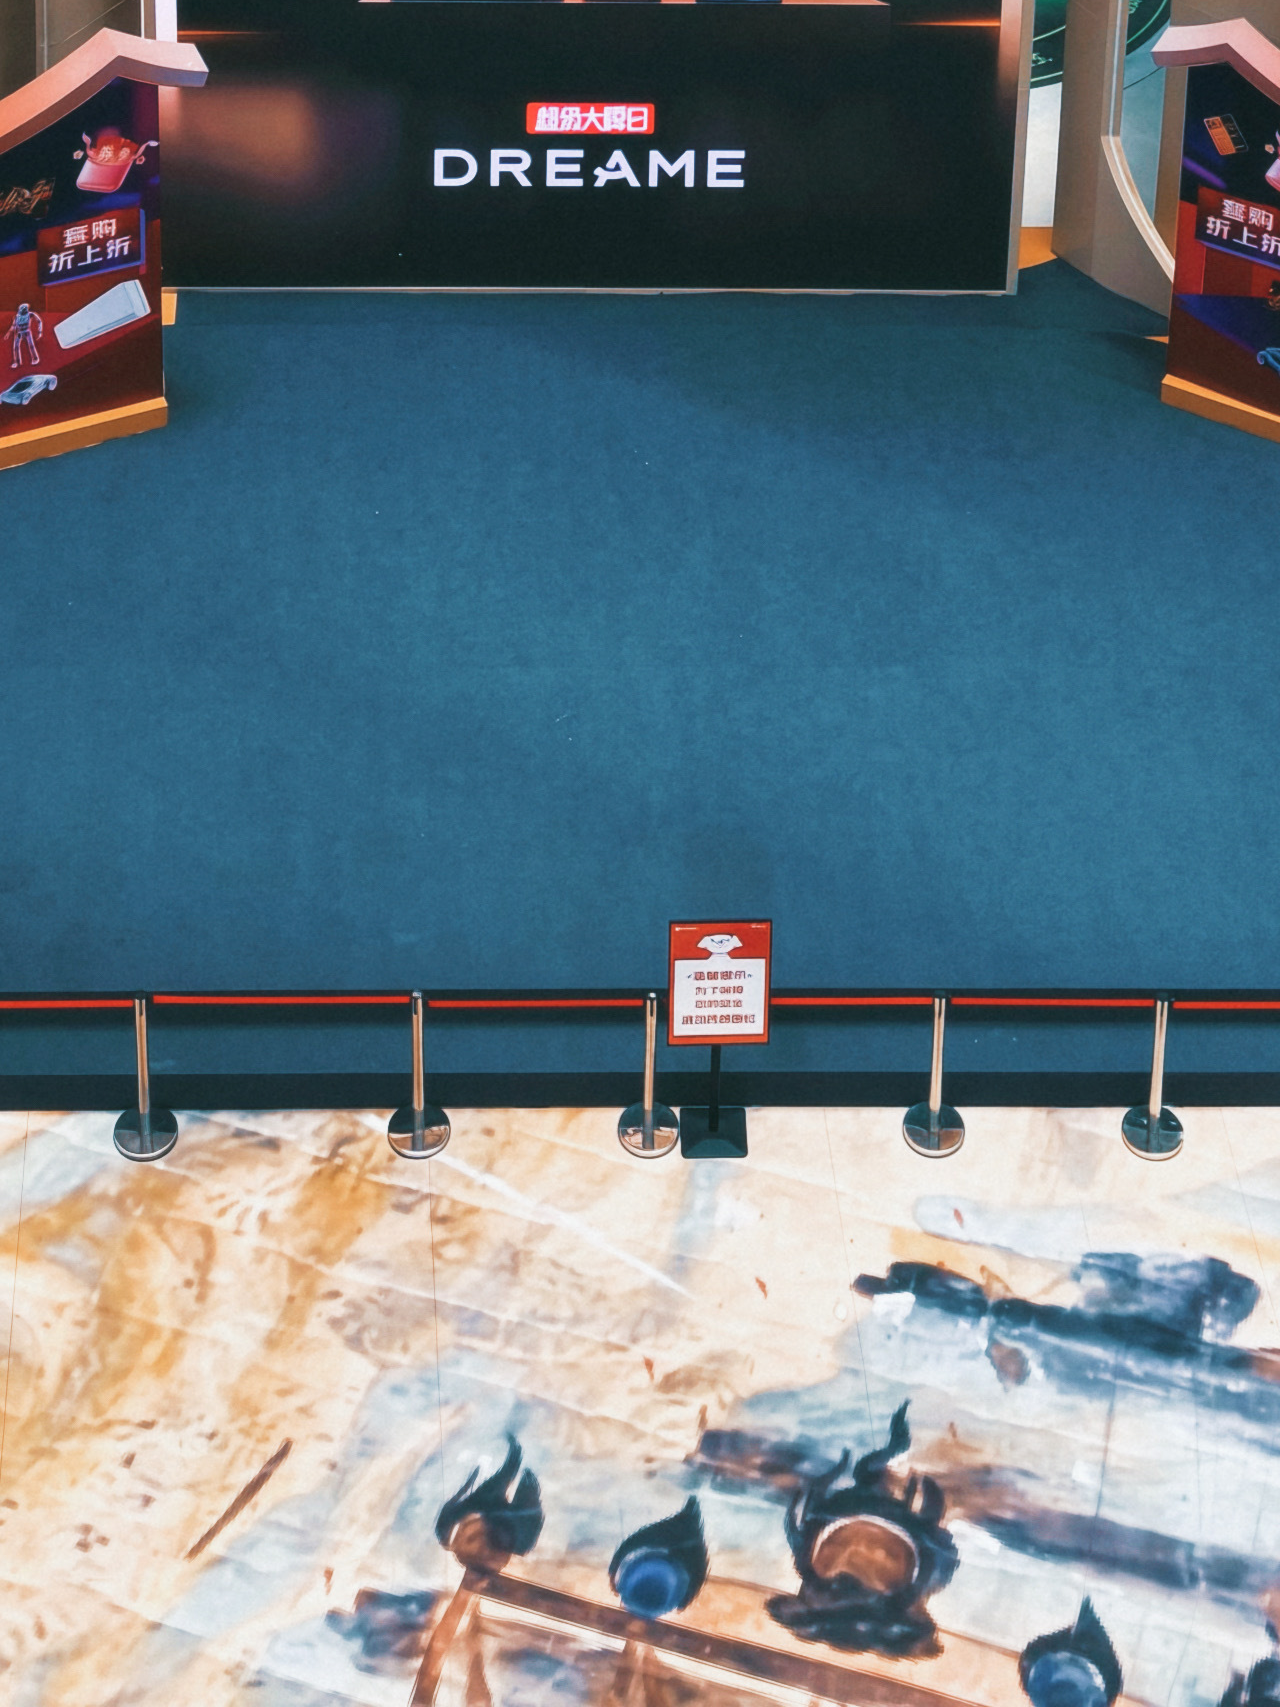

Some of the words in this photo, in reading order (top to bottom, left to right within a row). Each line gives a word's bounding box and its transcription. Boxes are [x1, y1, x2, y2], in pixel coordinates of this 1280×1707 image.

[432, 147, 746, 189] DREAME
[48, 235, 132, 275] 折上折
